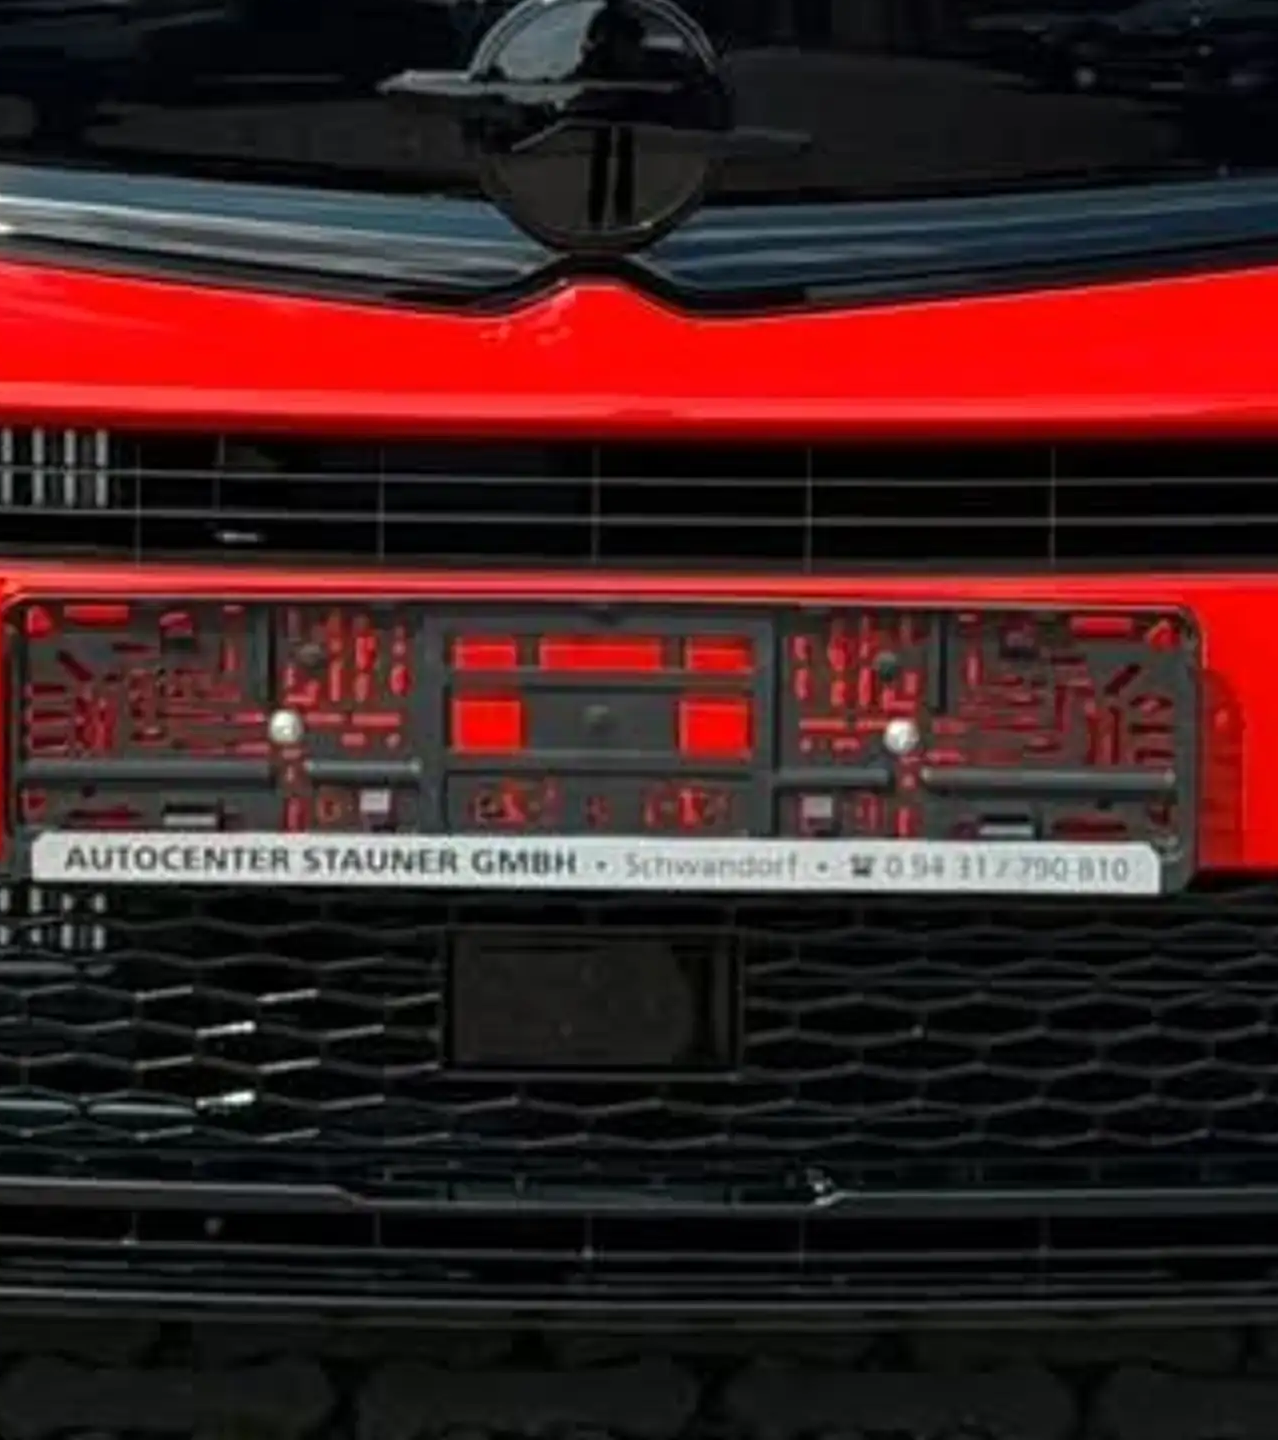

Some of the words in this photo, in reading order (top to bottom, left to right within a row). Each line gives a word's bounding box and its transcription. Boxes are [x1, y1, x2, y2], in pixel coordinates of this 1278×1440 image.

[64, 844, 290, 871] AUTOCENTER
[303, 847, 457, 874] STAUNER
[471, 849, 576, 874] GMBH
[624, 851, 798, 879] Schwandorf
